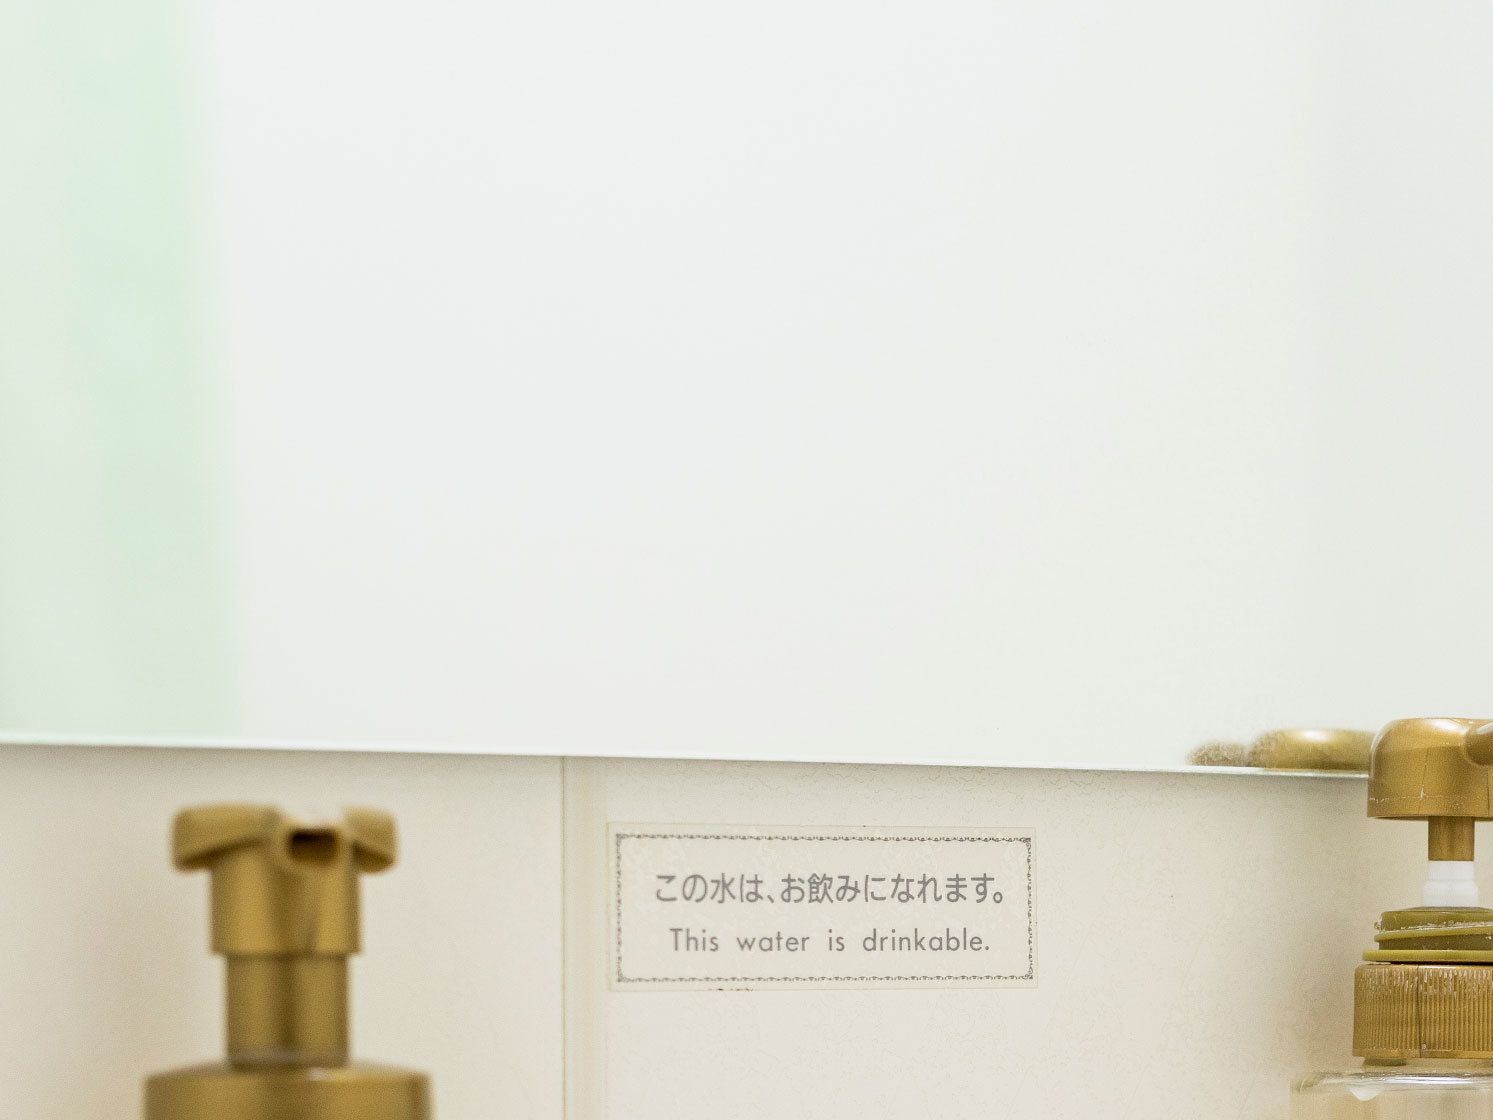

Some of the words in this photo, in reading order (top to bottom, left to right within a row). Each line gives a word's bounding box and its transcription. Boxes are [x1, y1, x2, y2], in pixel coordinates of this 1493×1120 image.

[655, 872, 1004, 905] この水は、お飲みになれます。
[670, 928, 720, 952] This
[736, 930, 811, 953] water
[828, 928, 846, 952] is
[862, 928, 991, 953] drinkable.
